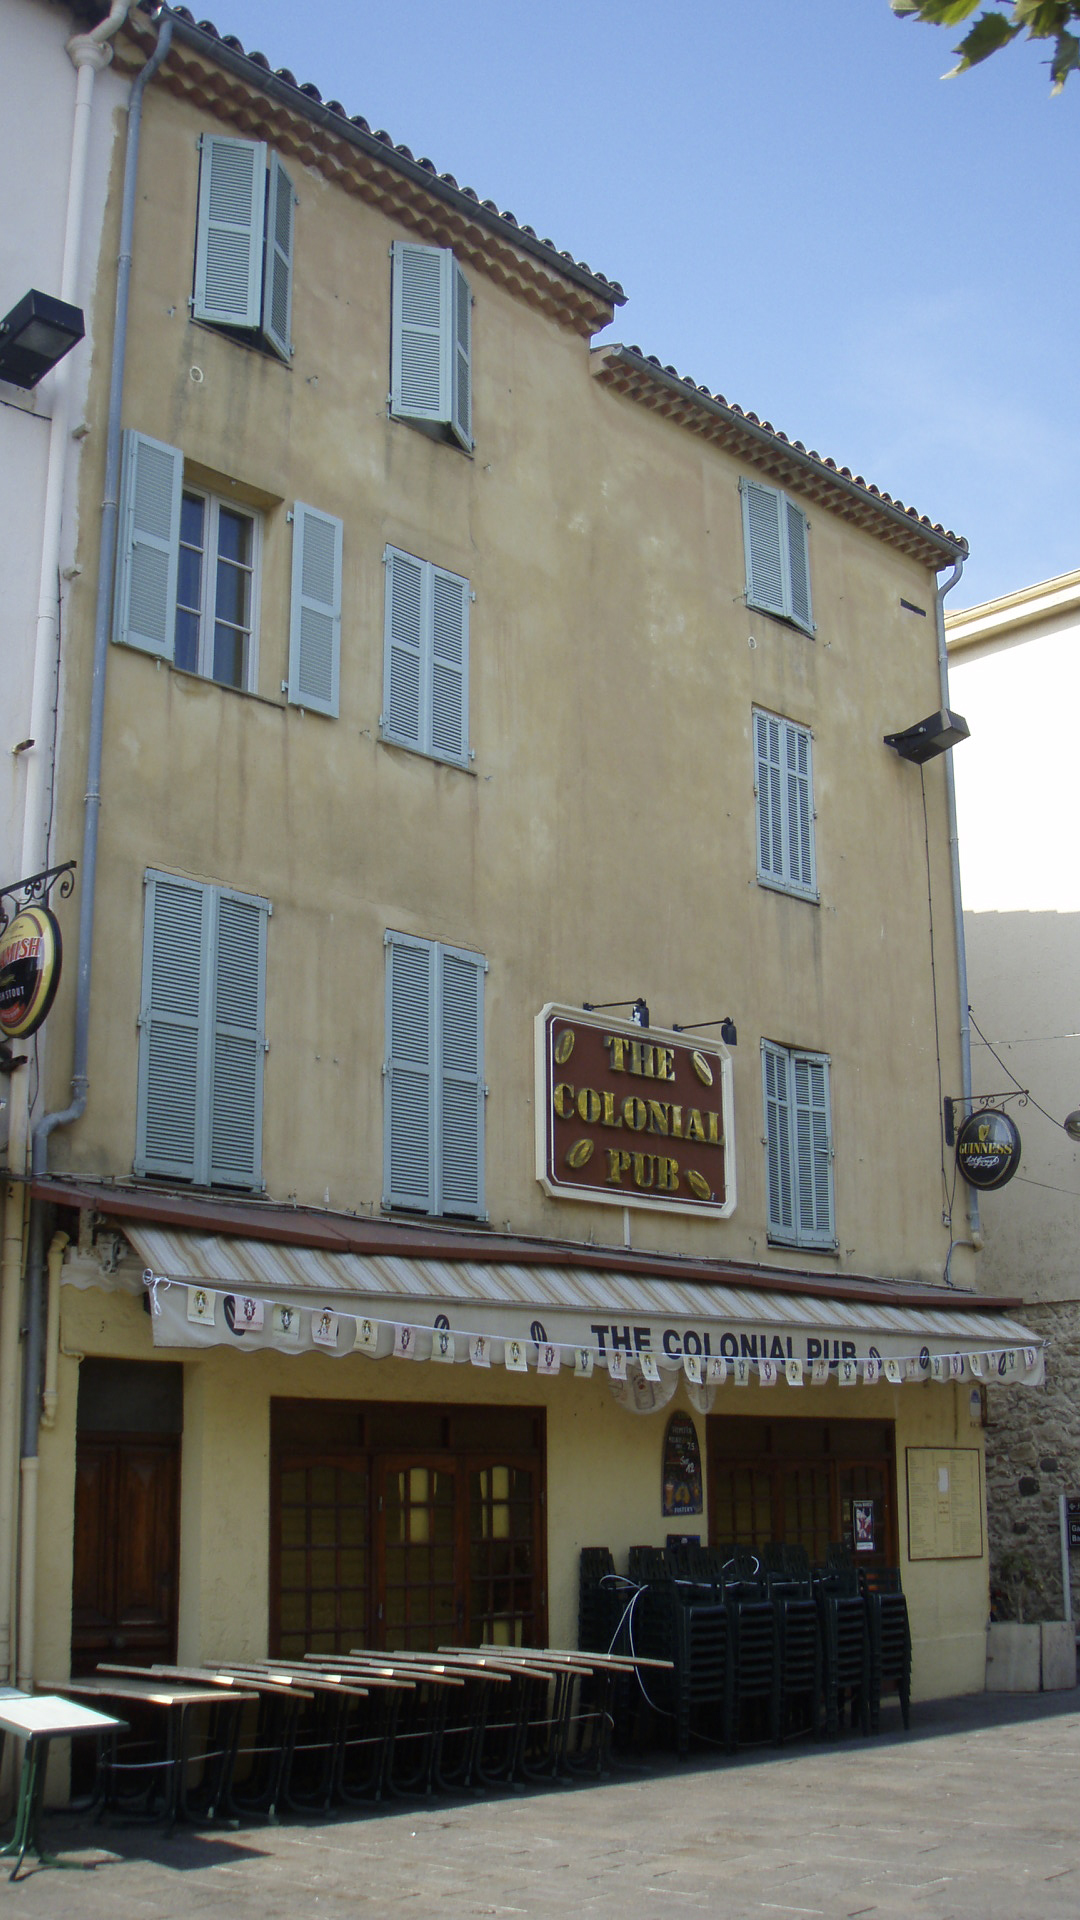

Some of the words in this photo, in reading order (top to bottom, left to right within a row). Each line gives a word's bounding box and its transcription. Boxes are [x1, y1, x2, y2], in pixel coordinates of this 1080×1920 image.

[5, 985, 25, 999] STOUT
[604, 1035, 675, 1081] THE
[554, 1083, 724, 1145] COLONIAL
[605, 1148, 679, 1191] PUB
[959, 1143, 1012, 1155] GUINNESS
[591, 1325, 653, 1357] THE
[663, 1329, 796, 1365] COLONIAL
[807, 1337, 857, 1368] PUB
